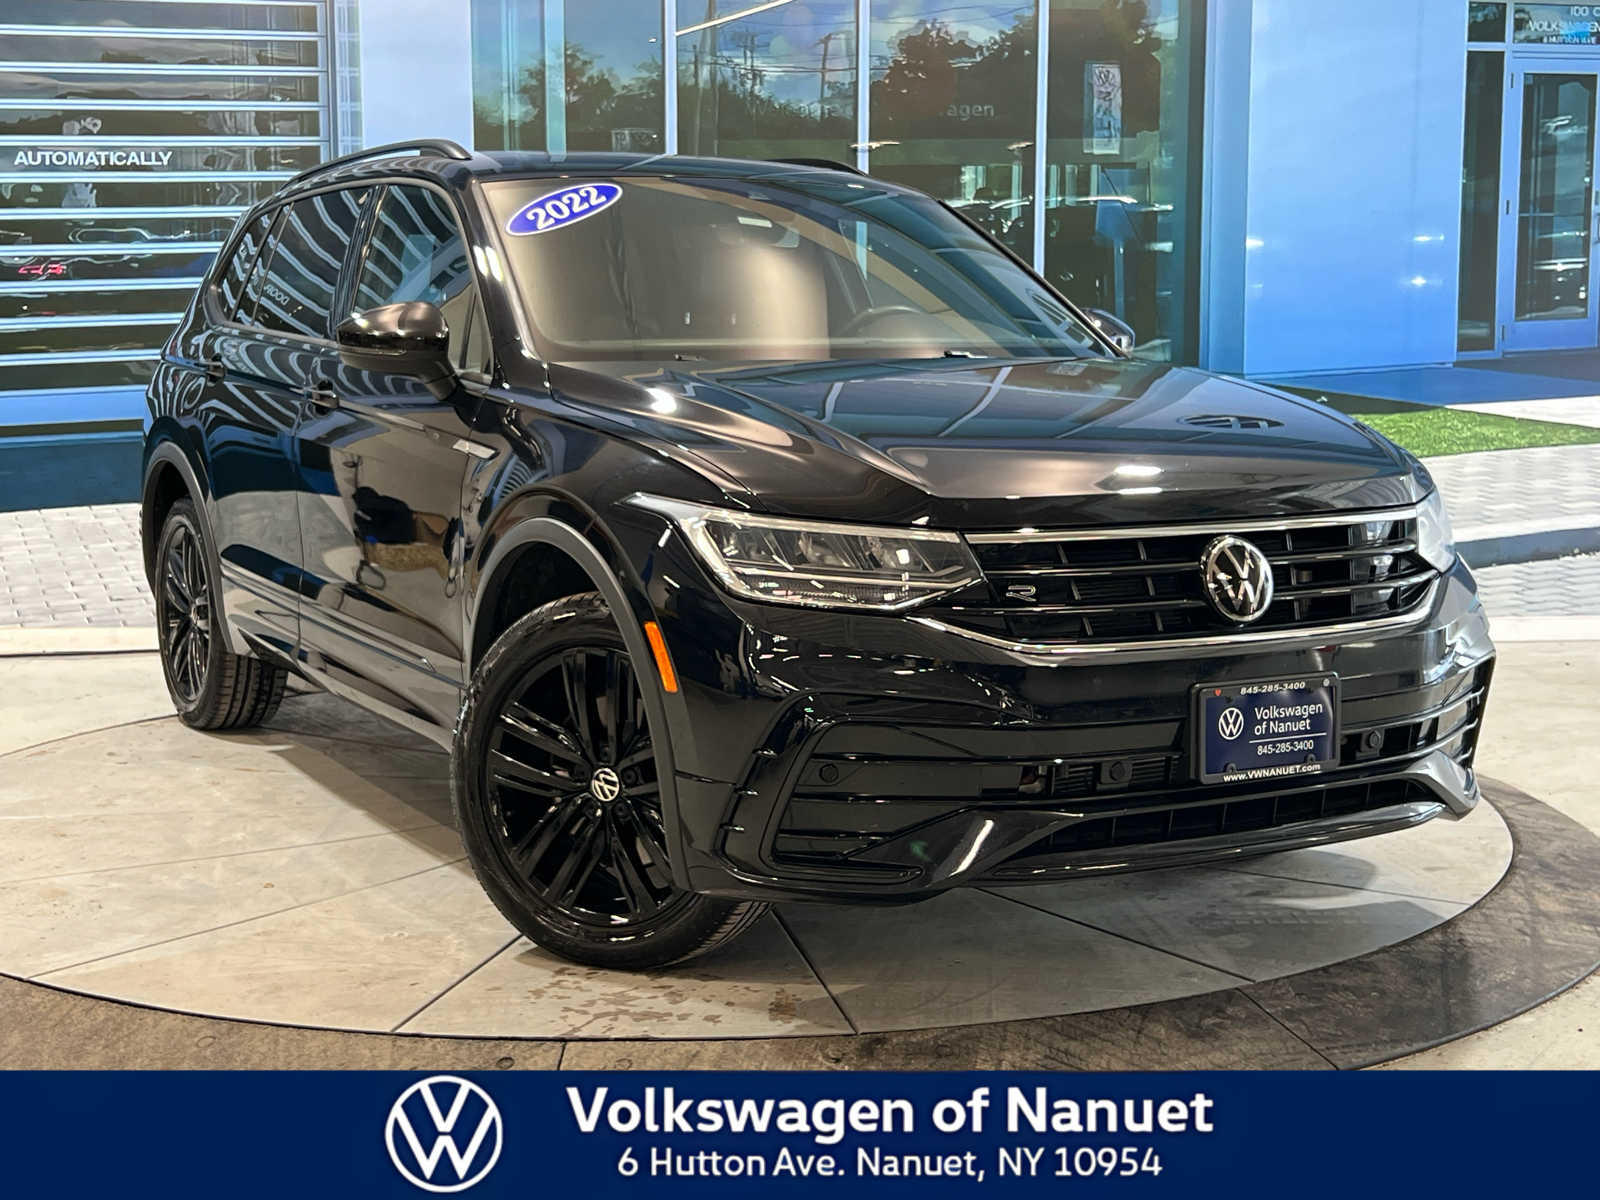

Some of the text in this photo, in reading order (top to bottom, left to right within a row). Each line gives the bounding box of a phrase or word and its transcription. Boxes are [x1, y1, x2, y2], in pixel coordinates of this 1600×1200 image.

[13, 150, 173, 166] AUTOMATICALLY
[526, 186, 607, 230] 2022
[1240, 681, 1306, 695] 845-285-3400
[1254, 703, 1323, 720] Volkswagen
[1254, 718, 1311, 735] of Nanuet
[1257, 739, 1314, 756] 845-285-3400
[1223, 763, 1321, 782] www.VWNANUET.com
